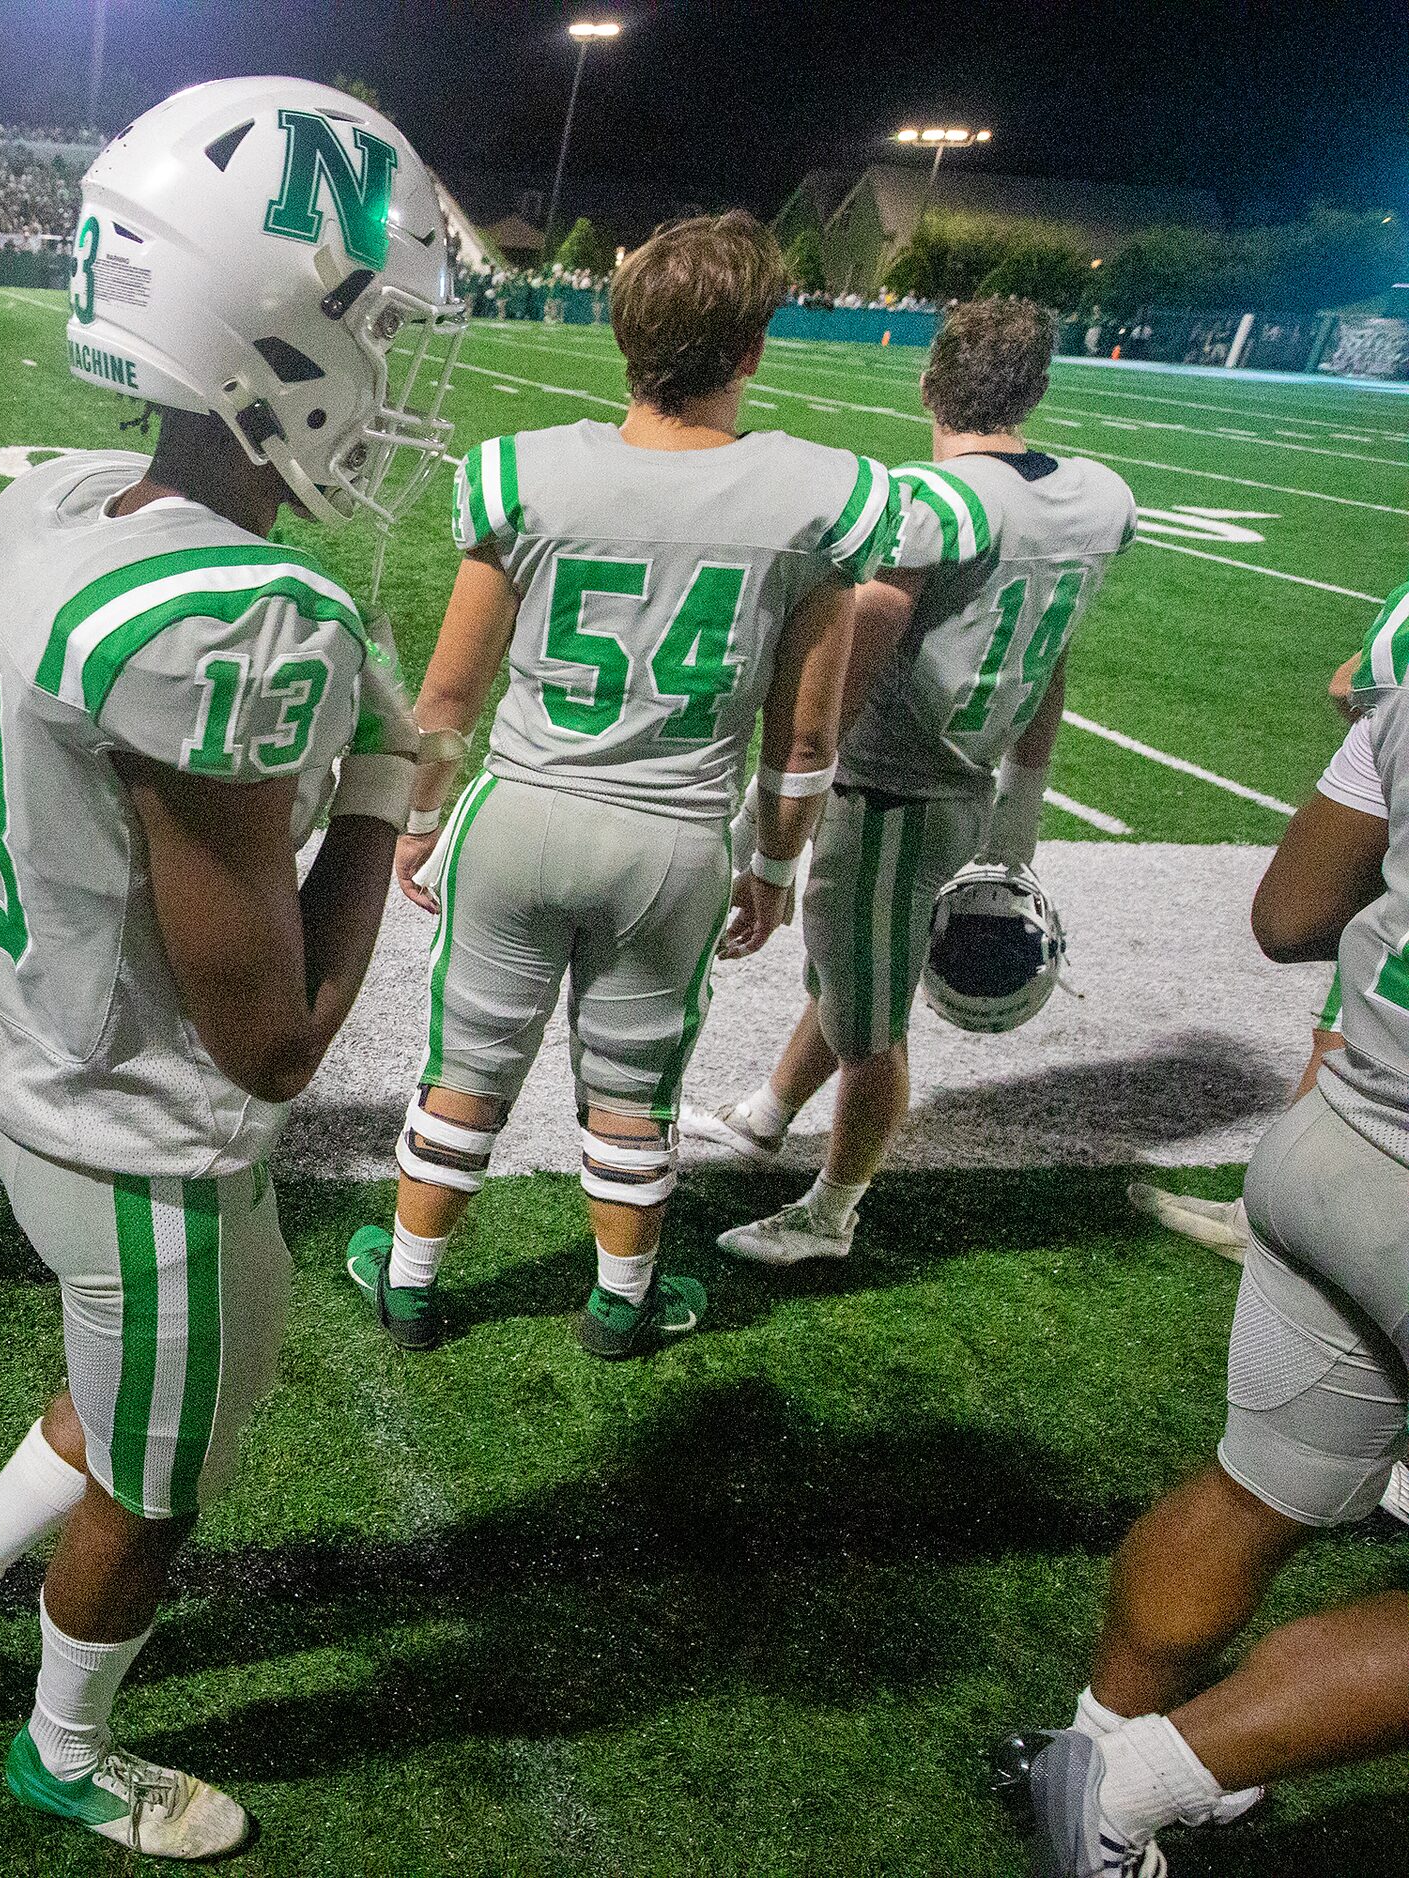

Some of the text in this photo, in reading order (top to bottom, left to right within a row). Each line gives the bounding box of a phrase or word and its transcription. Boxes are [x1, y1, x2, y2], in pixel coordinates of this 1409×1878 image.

[73, 216, 100, 325] 3
[262, 108, 398, 272] N
[178, 649, 335, 777] 13
[538, 553, 752, 745] 54
[941, 567, 1090, 736] 14
